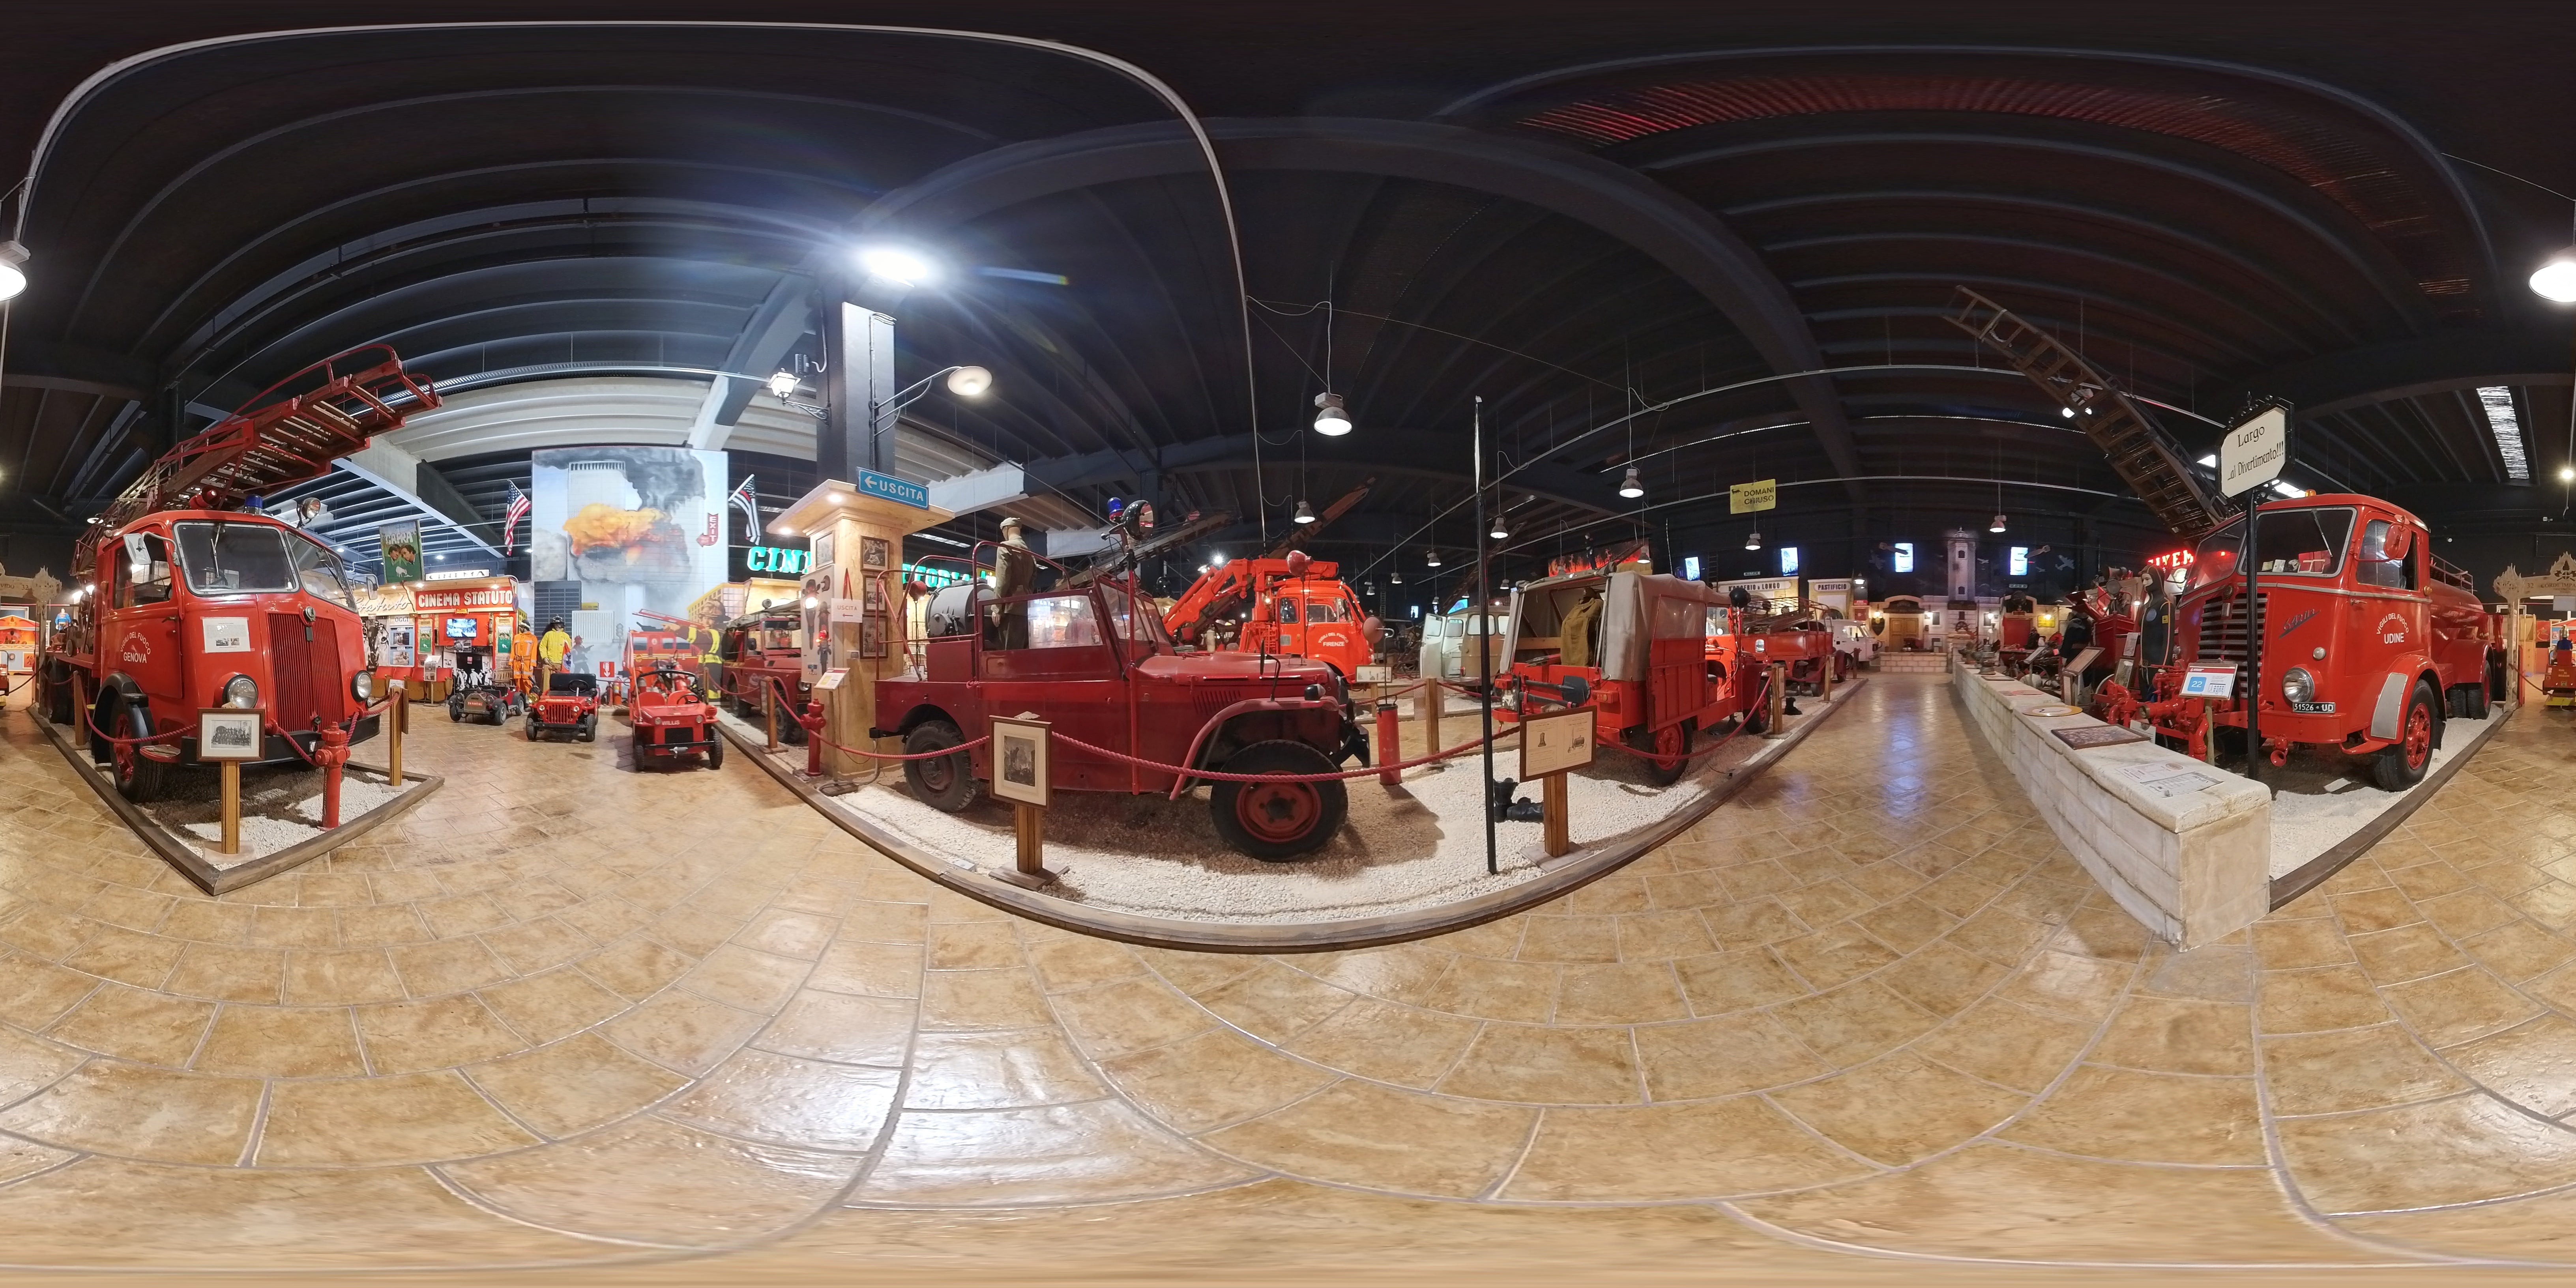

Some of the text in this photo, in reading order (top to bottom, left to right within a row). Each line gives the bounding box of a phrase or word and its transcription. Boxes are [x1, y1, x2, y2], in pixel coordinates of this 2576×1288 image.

[2238, 427, 2265, 447] Largo
[2238, 441, 2284, 476] Divertimento!!!
[879, 480, 924, 502] USCITA
[1744, 487, 1774, 496] DOMANI
[1744, 495, 1774, 504] CHIUSO
[418, 590, 512, 608] CINEMA STATUTO
[2376, 616, 2388, 634] VIGILI
[2397, 614, 2409, 633] FUOCO
[120, 635, 129, 652] VIGILI
[137, 632, 151, 655] FUOCO
[1318, 634, 1328, 643] VIGILI
[1336, 633, 1349, 643] FUOCO
[2384, 633, 2405, 644] UDINE
[124, 652, 147, 663] GENOVA
